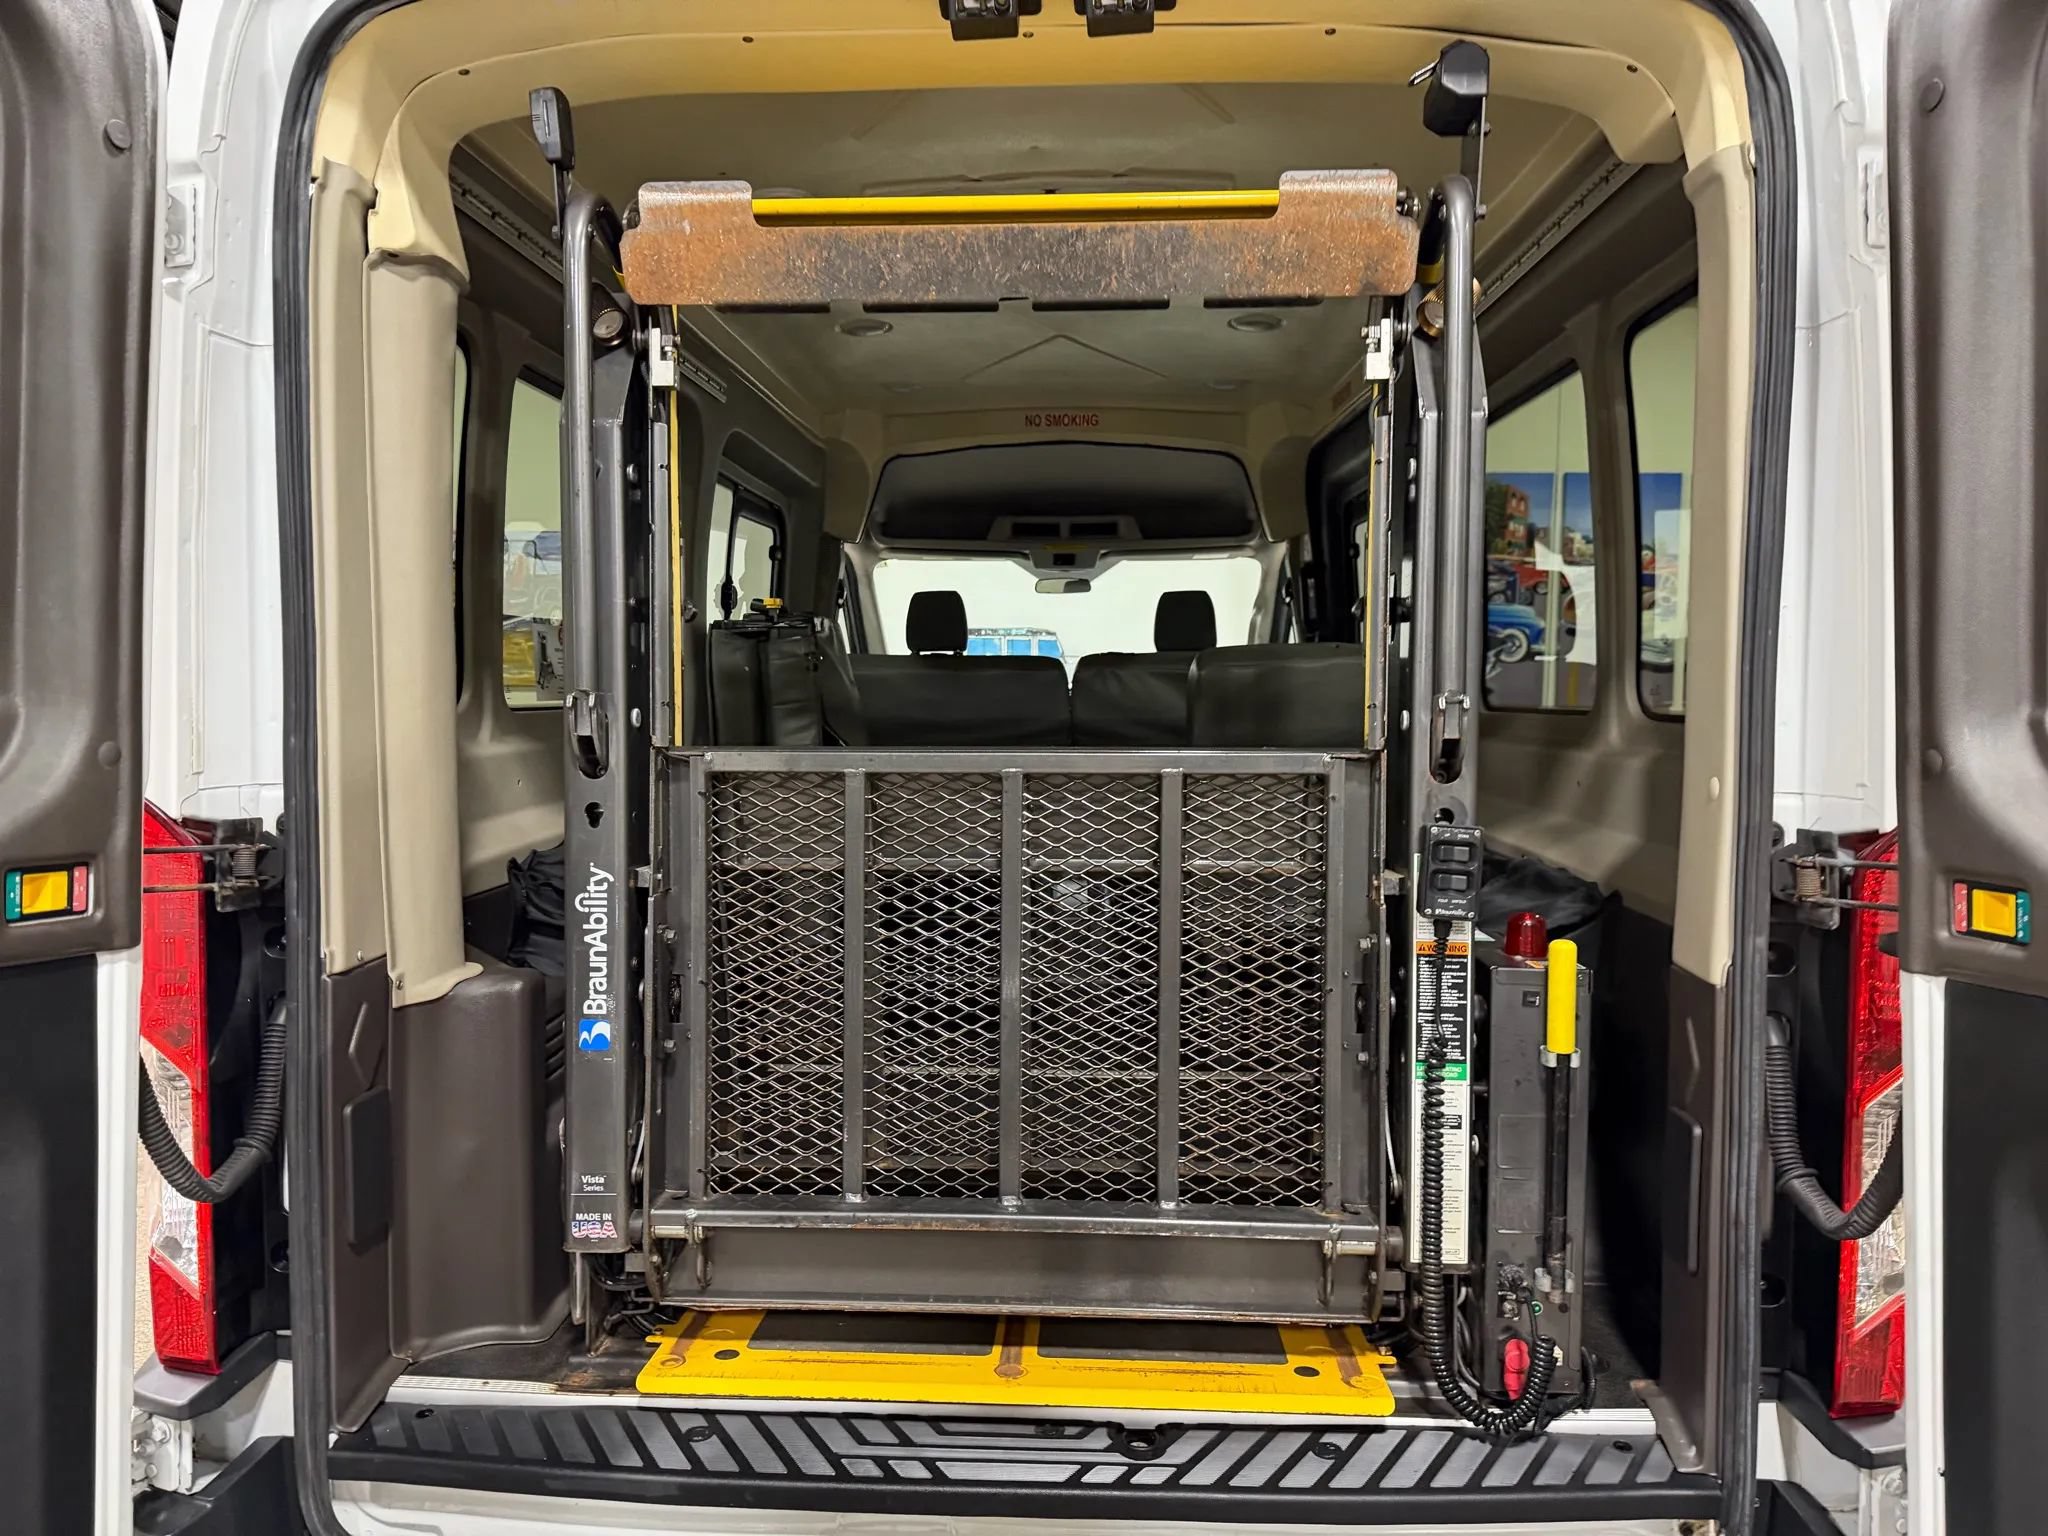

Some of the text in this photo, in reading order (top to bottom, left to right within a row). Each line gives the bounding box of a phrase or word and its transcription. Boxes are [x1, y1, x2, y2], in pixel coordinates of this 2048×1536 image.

[1025, 413, 1099, 427] NO SMOKING
[575, 864, 614, 1015] BraunAbility
[581, 1175, 605, 1184] Vista
[583, 1184, 604, 1192] Series
[576, 1212, 612, 1221] MADE IN
[571, 1221, 618, 1239] USA
